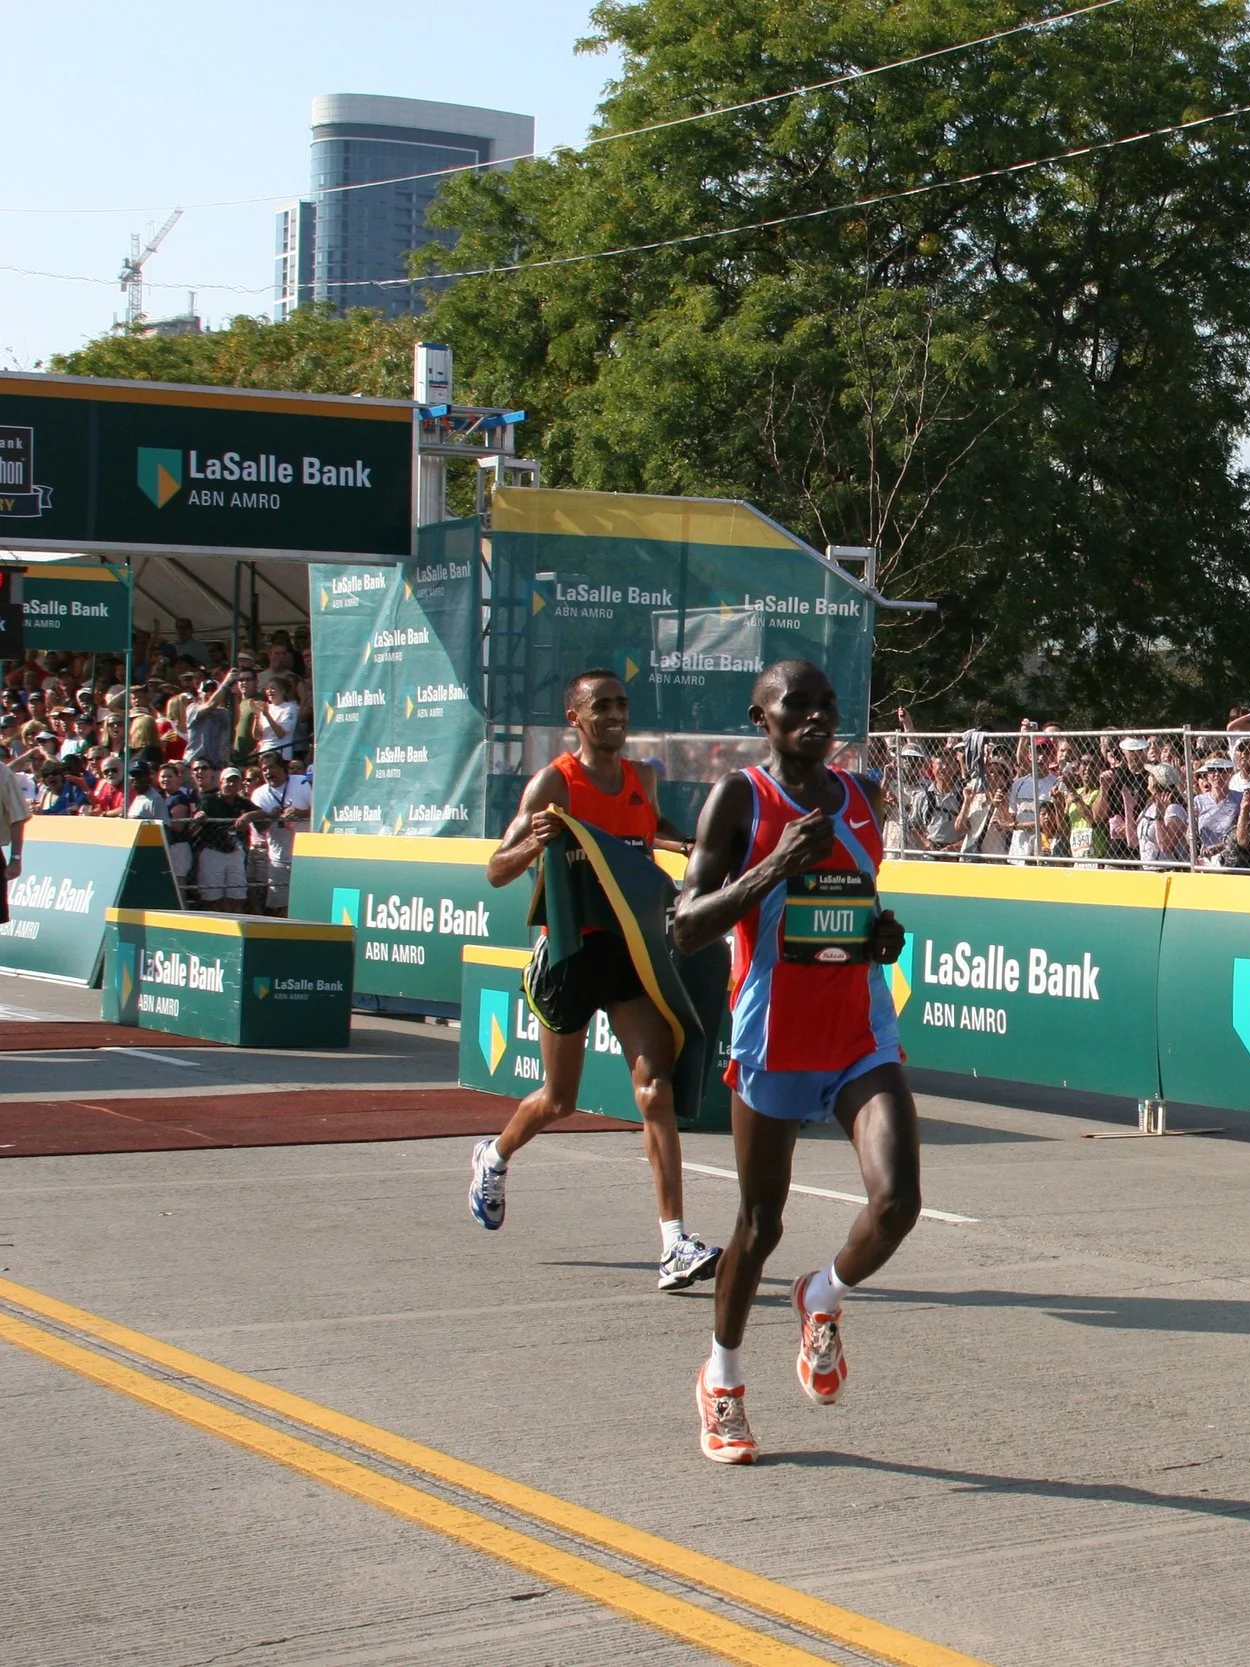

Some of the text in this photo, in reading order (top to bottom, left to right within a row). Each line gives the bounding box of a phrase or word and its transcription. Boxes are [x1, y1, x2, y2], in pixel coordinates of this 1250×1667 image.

[0, 437, 23, 449] ank
[189, 450, 371, 488] LaSalle Bank
[188, 491, 281, 510] ABN AMRO
[416, 561, 472, 583] LaSalle Bank
[332, 572, 386, 594] LaSalle Bank
[556, 583, 673, 607] LaSalle Bank
[744, 594, 860, 617] LaSalle Bank
[23, 600, 109, 617] aSalle Bank
[555, 606, 614, 619] ABN AMRO
[34, 619, 61, 629] AMRO
[743, 617, 801, 630] ABN AMRO
[373, 627, 430, 648] LaSalle Bank
[650, 650, 765, 673] LaSalle Bank
[648, 673, 705, 686] ABN AMRO
[336, 689, 386, 708] LaSalle Bank
[417, 683, 469, 703] LaSalle Bank
[376, 746, 428, 764] LaSalle Bank
[333, 805, 382, 822] LaSalle Bank
[409, 805, 442, 821] LaSalle
[819, 875, 862, 884] LaSalle Bank
[8, 875, 95, 914] LaSalle Bank
[366, 894, 490, 938] LaSalle Bank
[813, 910, 854, 932] IVUTI
[14, 920, 40, 940] AMRO
[365, 941, 425, 966] ABN AMRO
[139, 949, 224, 993] LaSalle Bank
[924, 940, 1100, 1001] LaSalle Bank
[275, 979, 343, 991] LaSalle Bank
[138, 994, 179, 1017] ABN AMRO
[923, 1001, 1007, 1035] ABN AMRO
[514, 1055, 539, 1080] ABN
